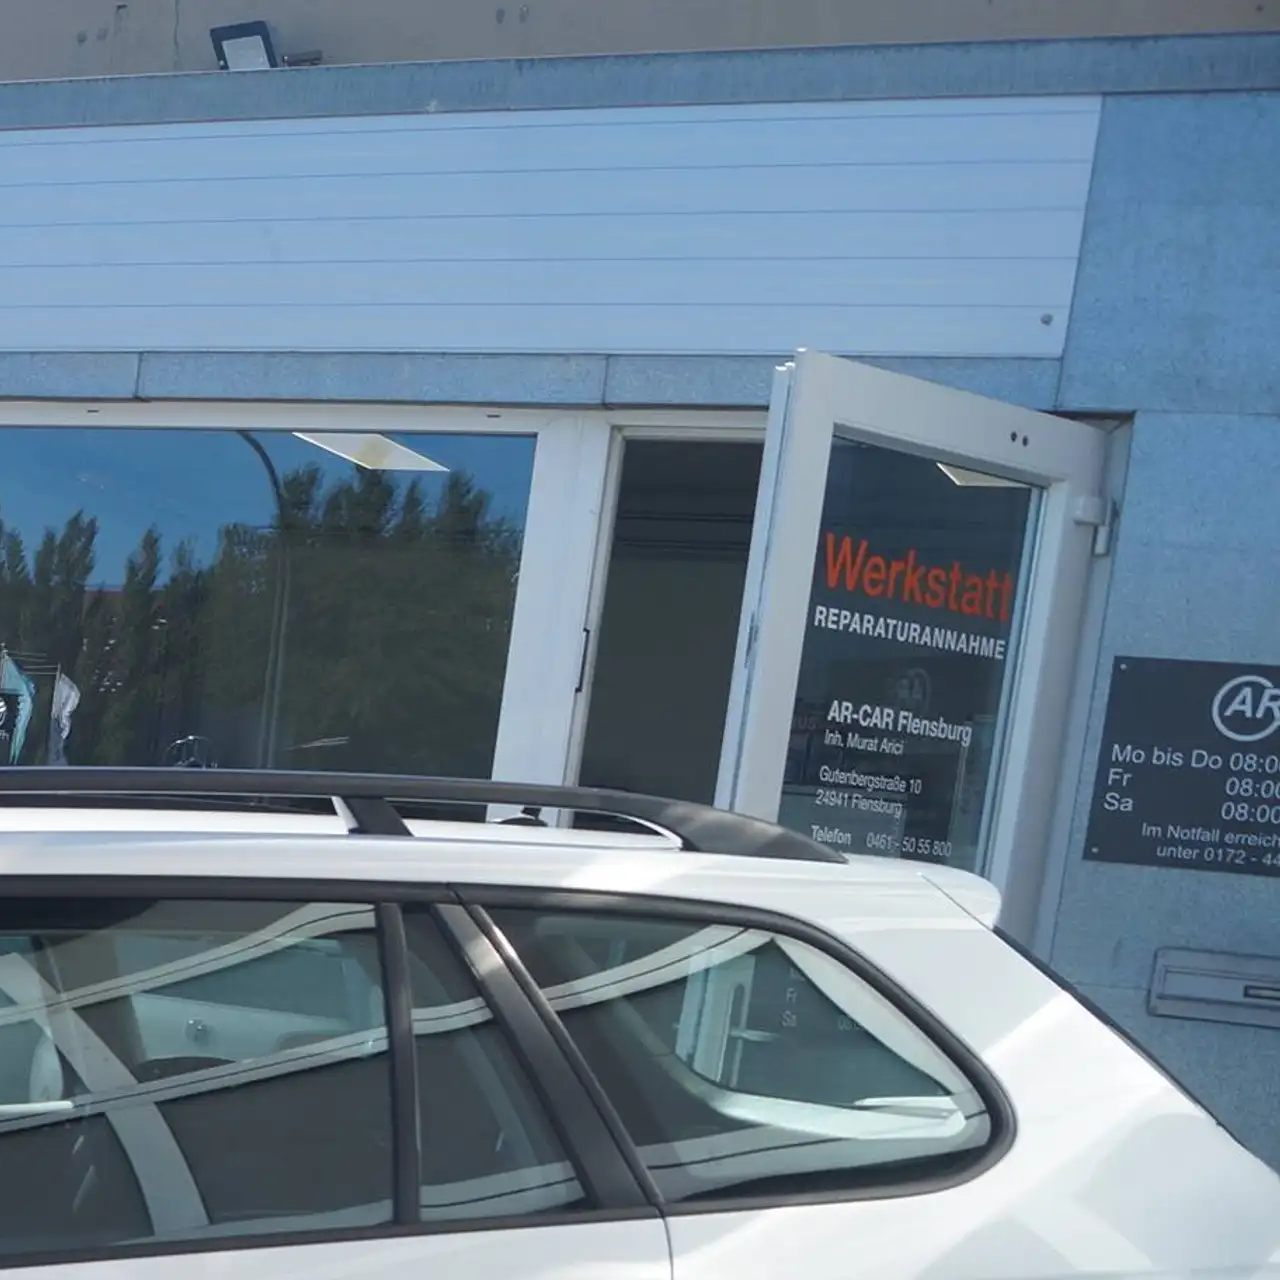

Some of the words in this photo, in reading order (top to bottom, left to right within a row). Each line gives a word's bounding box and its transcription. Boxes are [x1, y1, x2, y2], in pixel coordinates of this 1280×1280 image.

[825, 532, 1014, 622] Werkstatt
[814, 605, 1006, 660] REPARATURANNAHME
[827, 700, 894, 731] AR-CAR
[897, 710, 972, 747] Flensburg
[824, 729, 844, 747] Inh.
[846, 732, 878, 751] Murat
[1111, 743, 1145, 764] Mo
[1152, 747, 1184, 767] bis
[1190, 749, 1223, 770] Do
[1229, 752, 1280, 774] 08:0
[819, 765, 906, 792] Gutenbergstraße
[910, 779, 922, 794] 10
[1108, 768, 1132, 787] Fr
[816, 789, 848, 808] 24941
[851, 794, 903, 818] Flensburg
[1103, 792, 1133, 812] Sa
[1221, 801, 1280, 824] 08:00
[811, 825, 852, 845] Telefon
[866, 832, 891, 849] 0461
[902, 836, 916, 852] 50
[917, 838, 931, 855] 55
[932, 840, 952, 857] 800
[1141, 822, 1162, 838] Im
[1166, 824, 1220, 843] Notfall
[1156, 845, 1200, 861] unter
[1204, 848, 1246, 865] 0172
